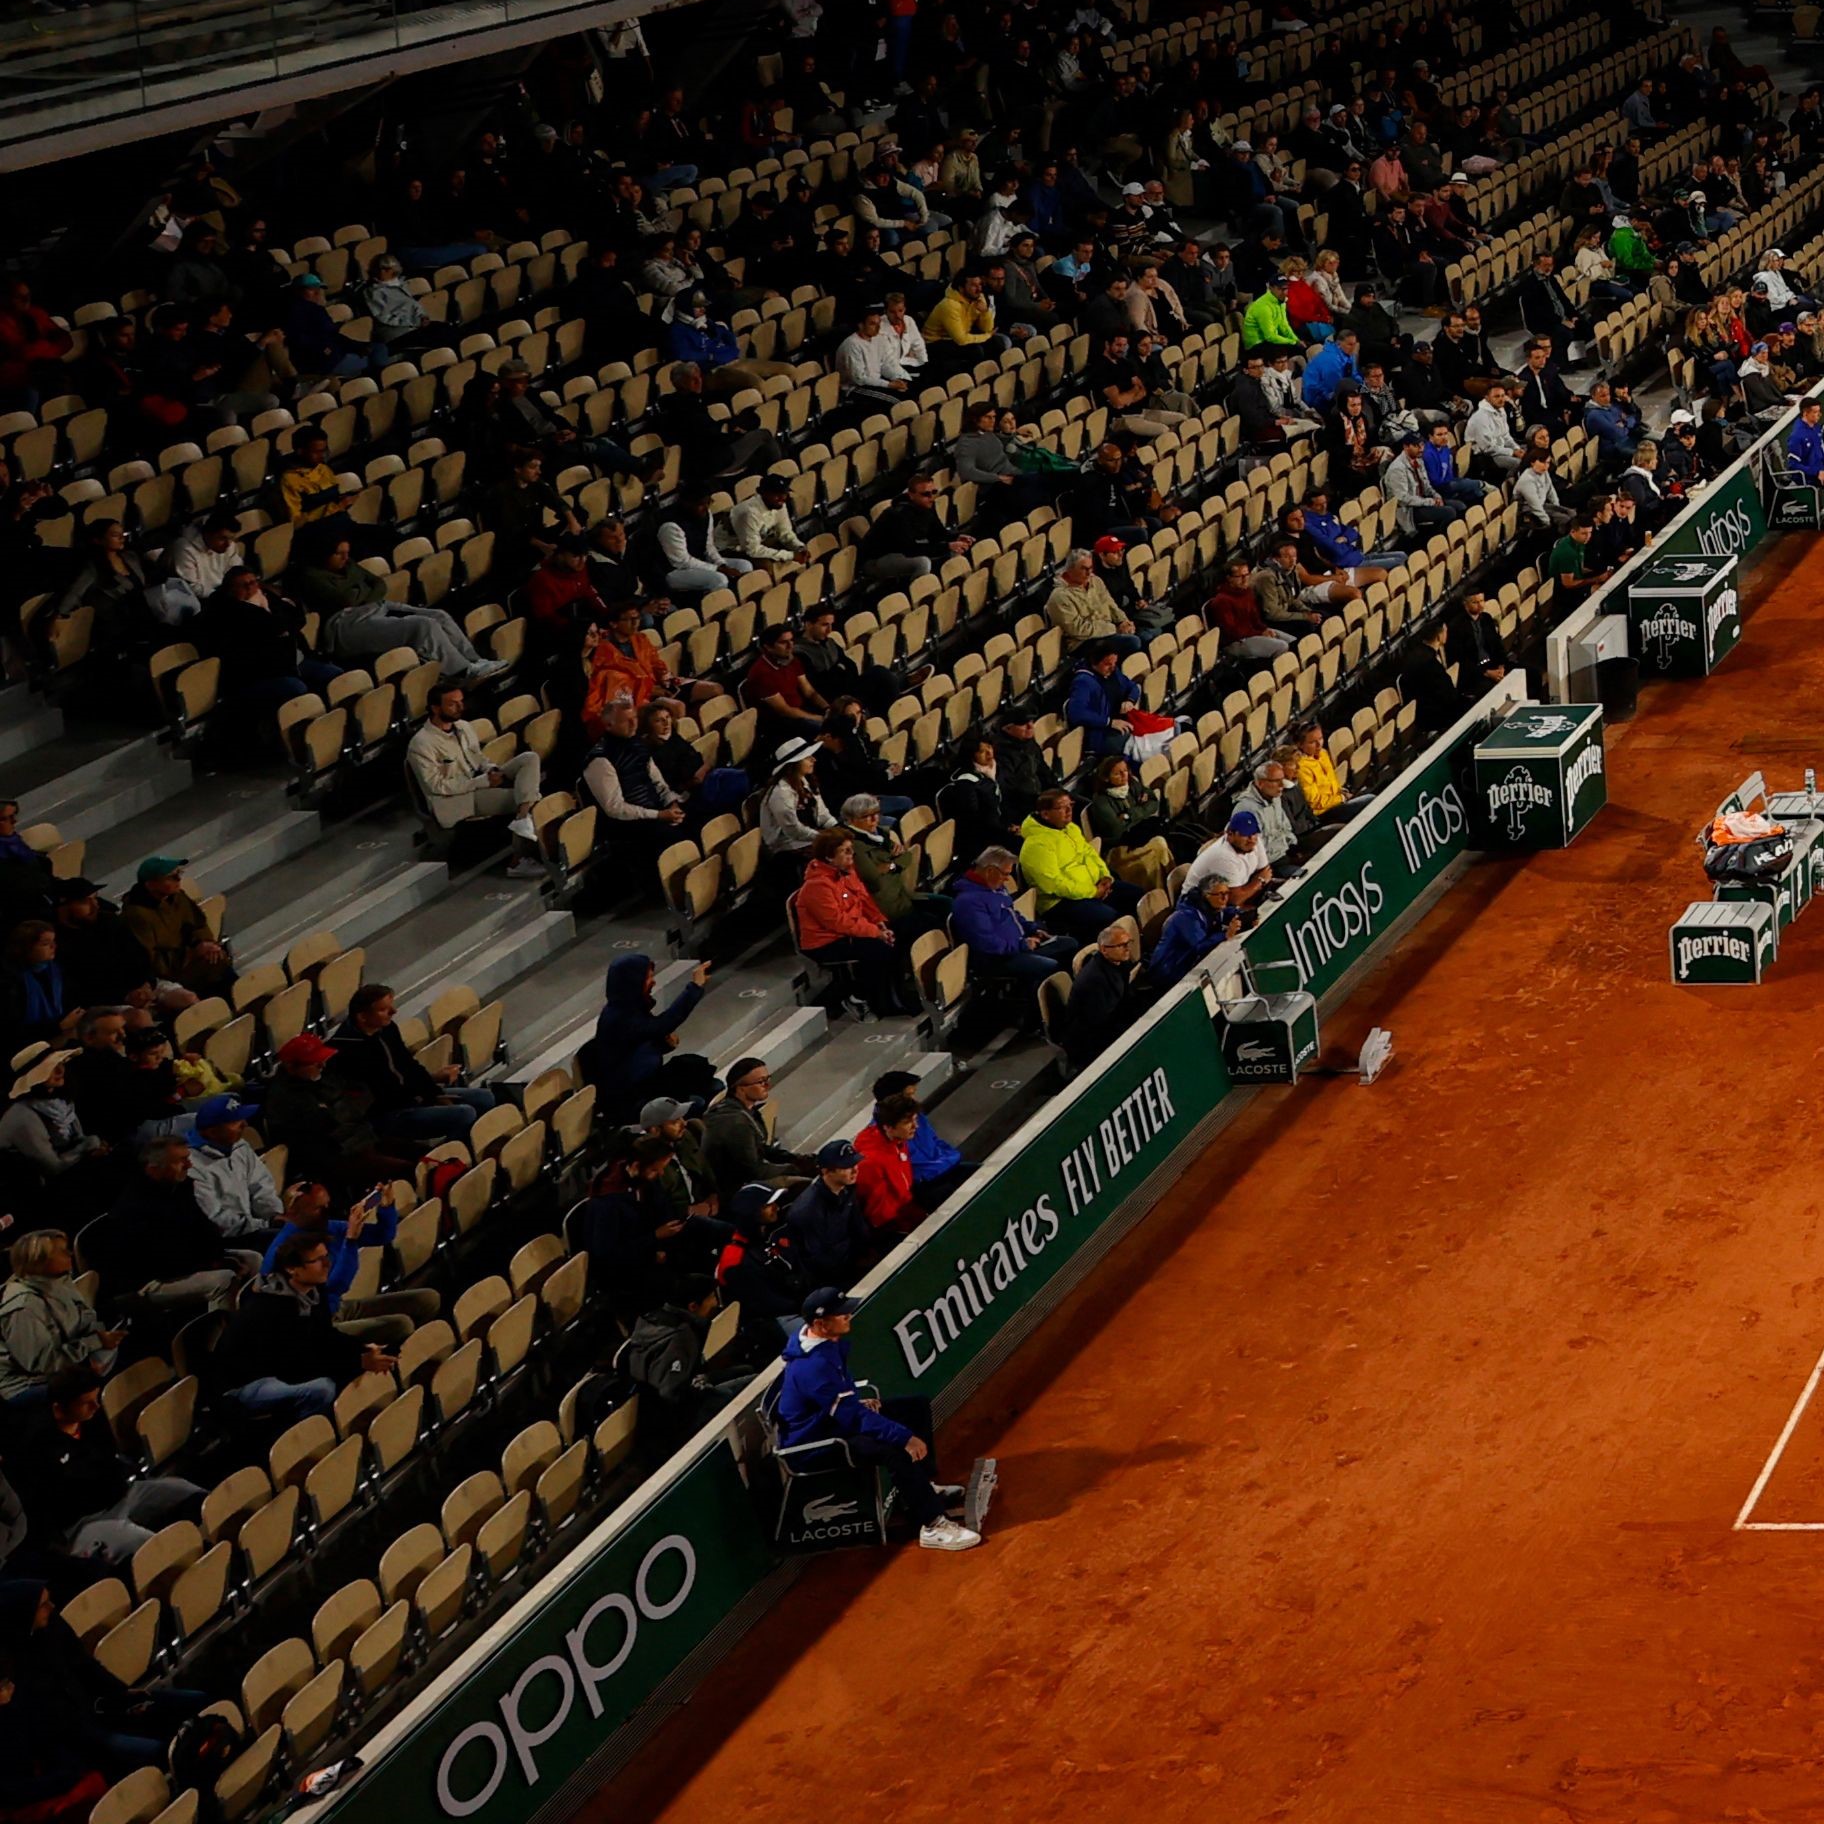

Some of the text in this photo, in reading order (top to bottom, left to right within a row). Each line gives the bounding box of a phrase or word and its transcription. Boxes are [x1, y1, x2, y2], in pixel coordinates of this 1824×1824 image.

[1775, 515, 1815, 524] LACOSTE
[1638, 617, 1698, 654] perrier
[1487, 777, 1553, 824] perrier
[1285, 860, 1385, 979] Infosys
[1677, 930, 1751, 980] perrier
[1227, 1062, 1289, 1076] LACOSTE
[892, 1064, 1176, 1379] Emirates FLY BETTER
[789, 1519, 876, 1545] LACOSTE
[435, 1533, 697, 1819] oppo
